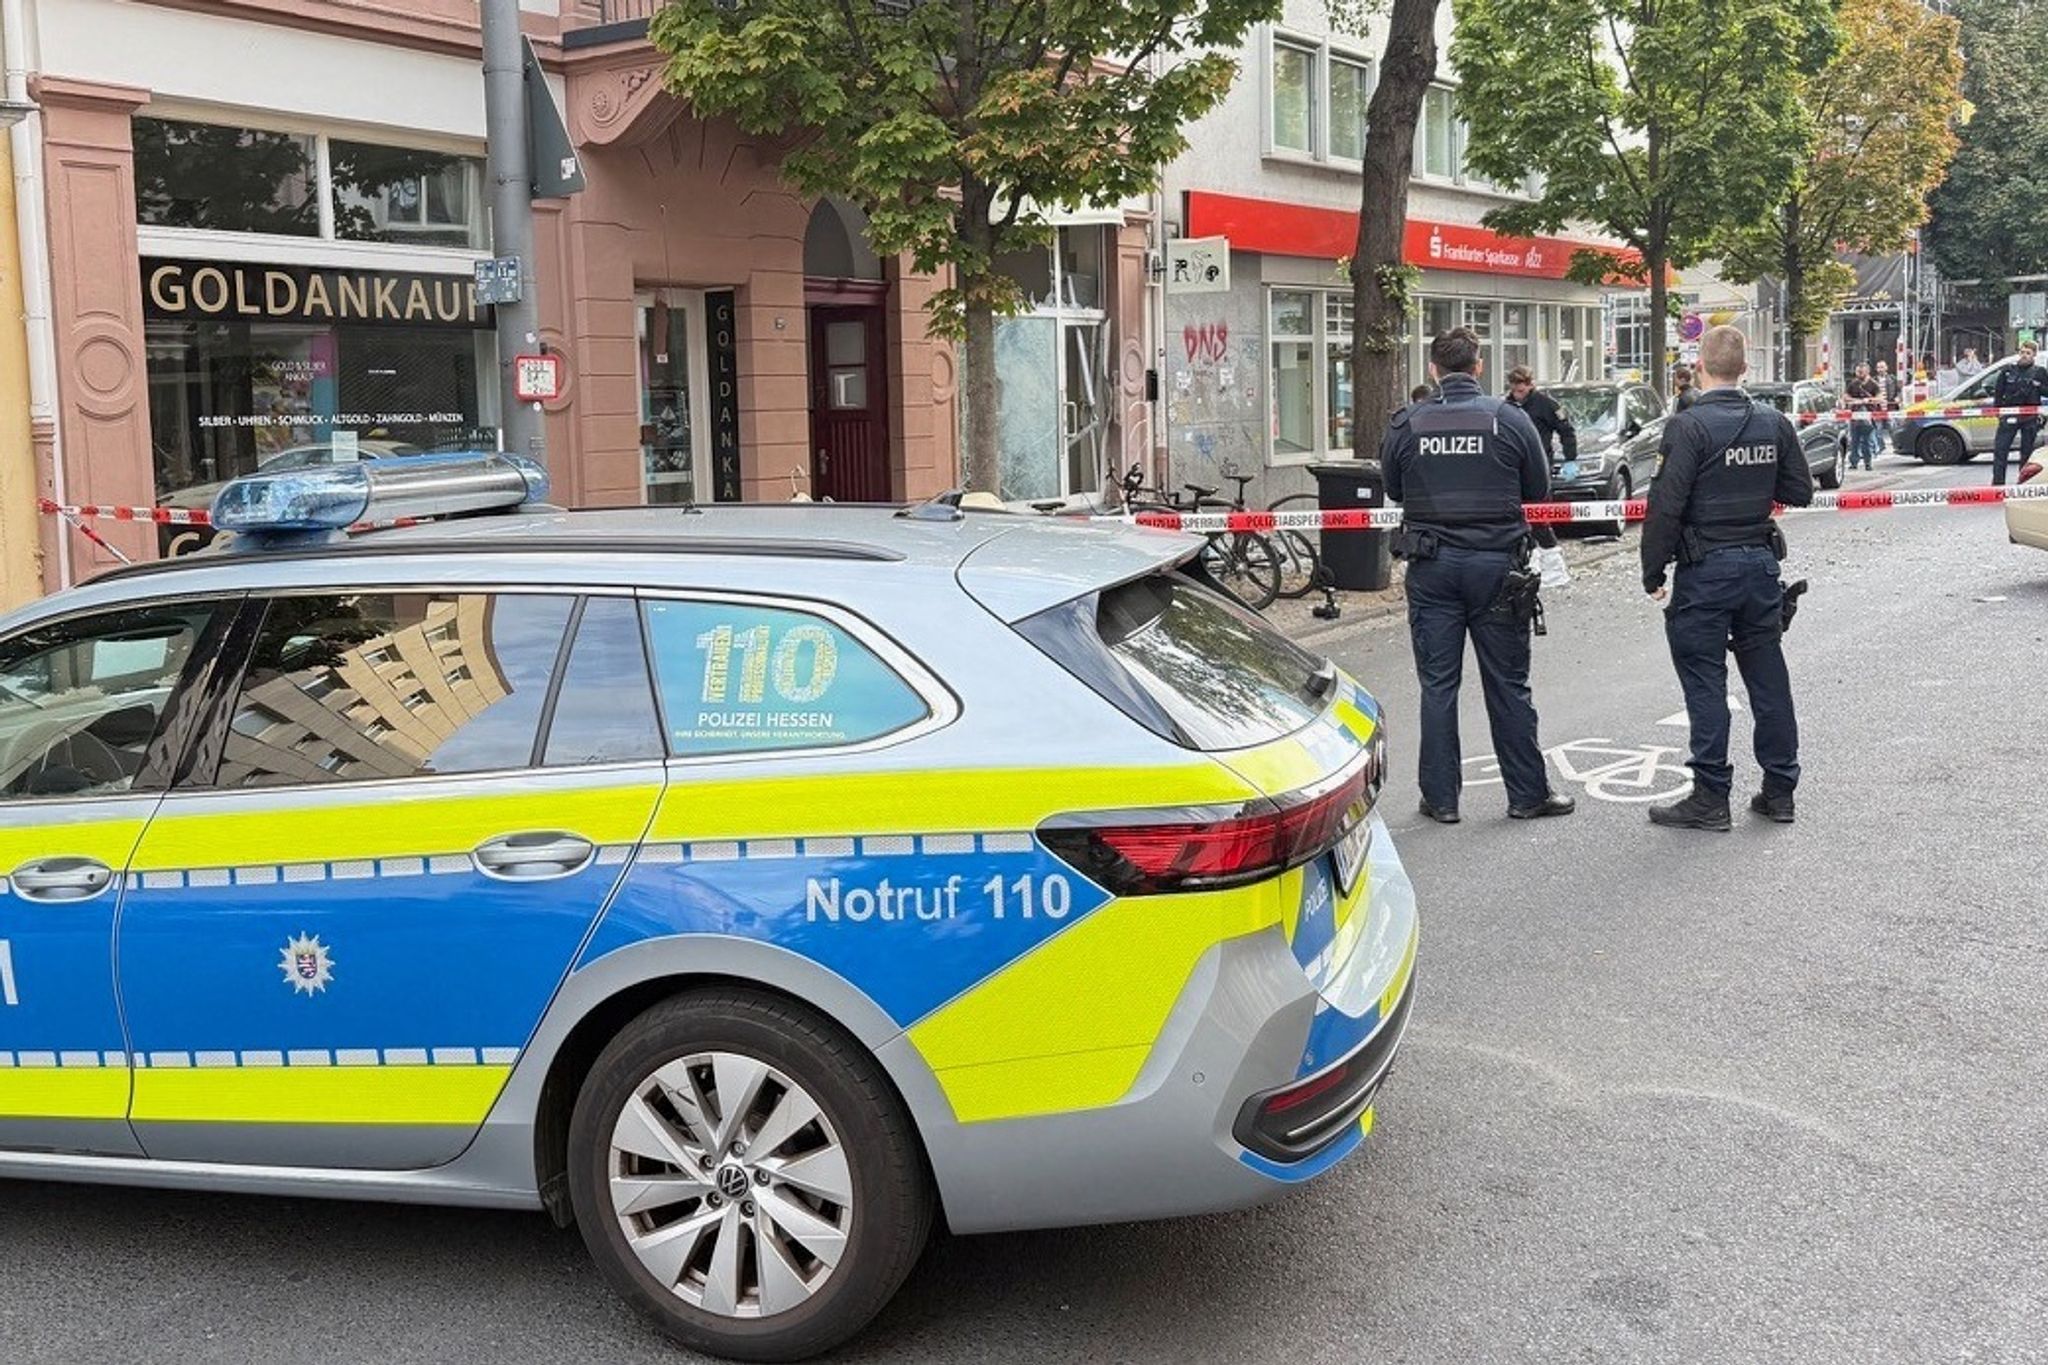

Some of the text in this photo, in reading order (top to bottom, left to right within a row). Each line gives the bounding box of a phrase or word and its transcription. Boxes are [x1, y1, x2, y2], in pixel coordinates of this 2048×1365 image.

[1443, 243, 1484, 262] Frankfurter
[1485, 247, 1519, 266] Sparkasse
[199, 411, 464, 426] SILBER UHREN SCHMUCK ALTGOLD ZAHNGOLD MÜNZEN
[1419, 436, 1483, 455] POLIZEI
[1246, 511, 1350, 528] POLIZEIABSPERRUNG
[696, 624, 838, 703] 110
[698, 712, 834, 728] POLIZEI HESSEN
[806, 873, 1072, 922] Notruf 110
